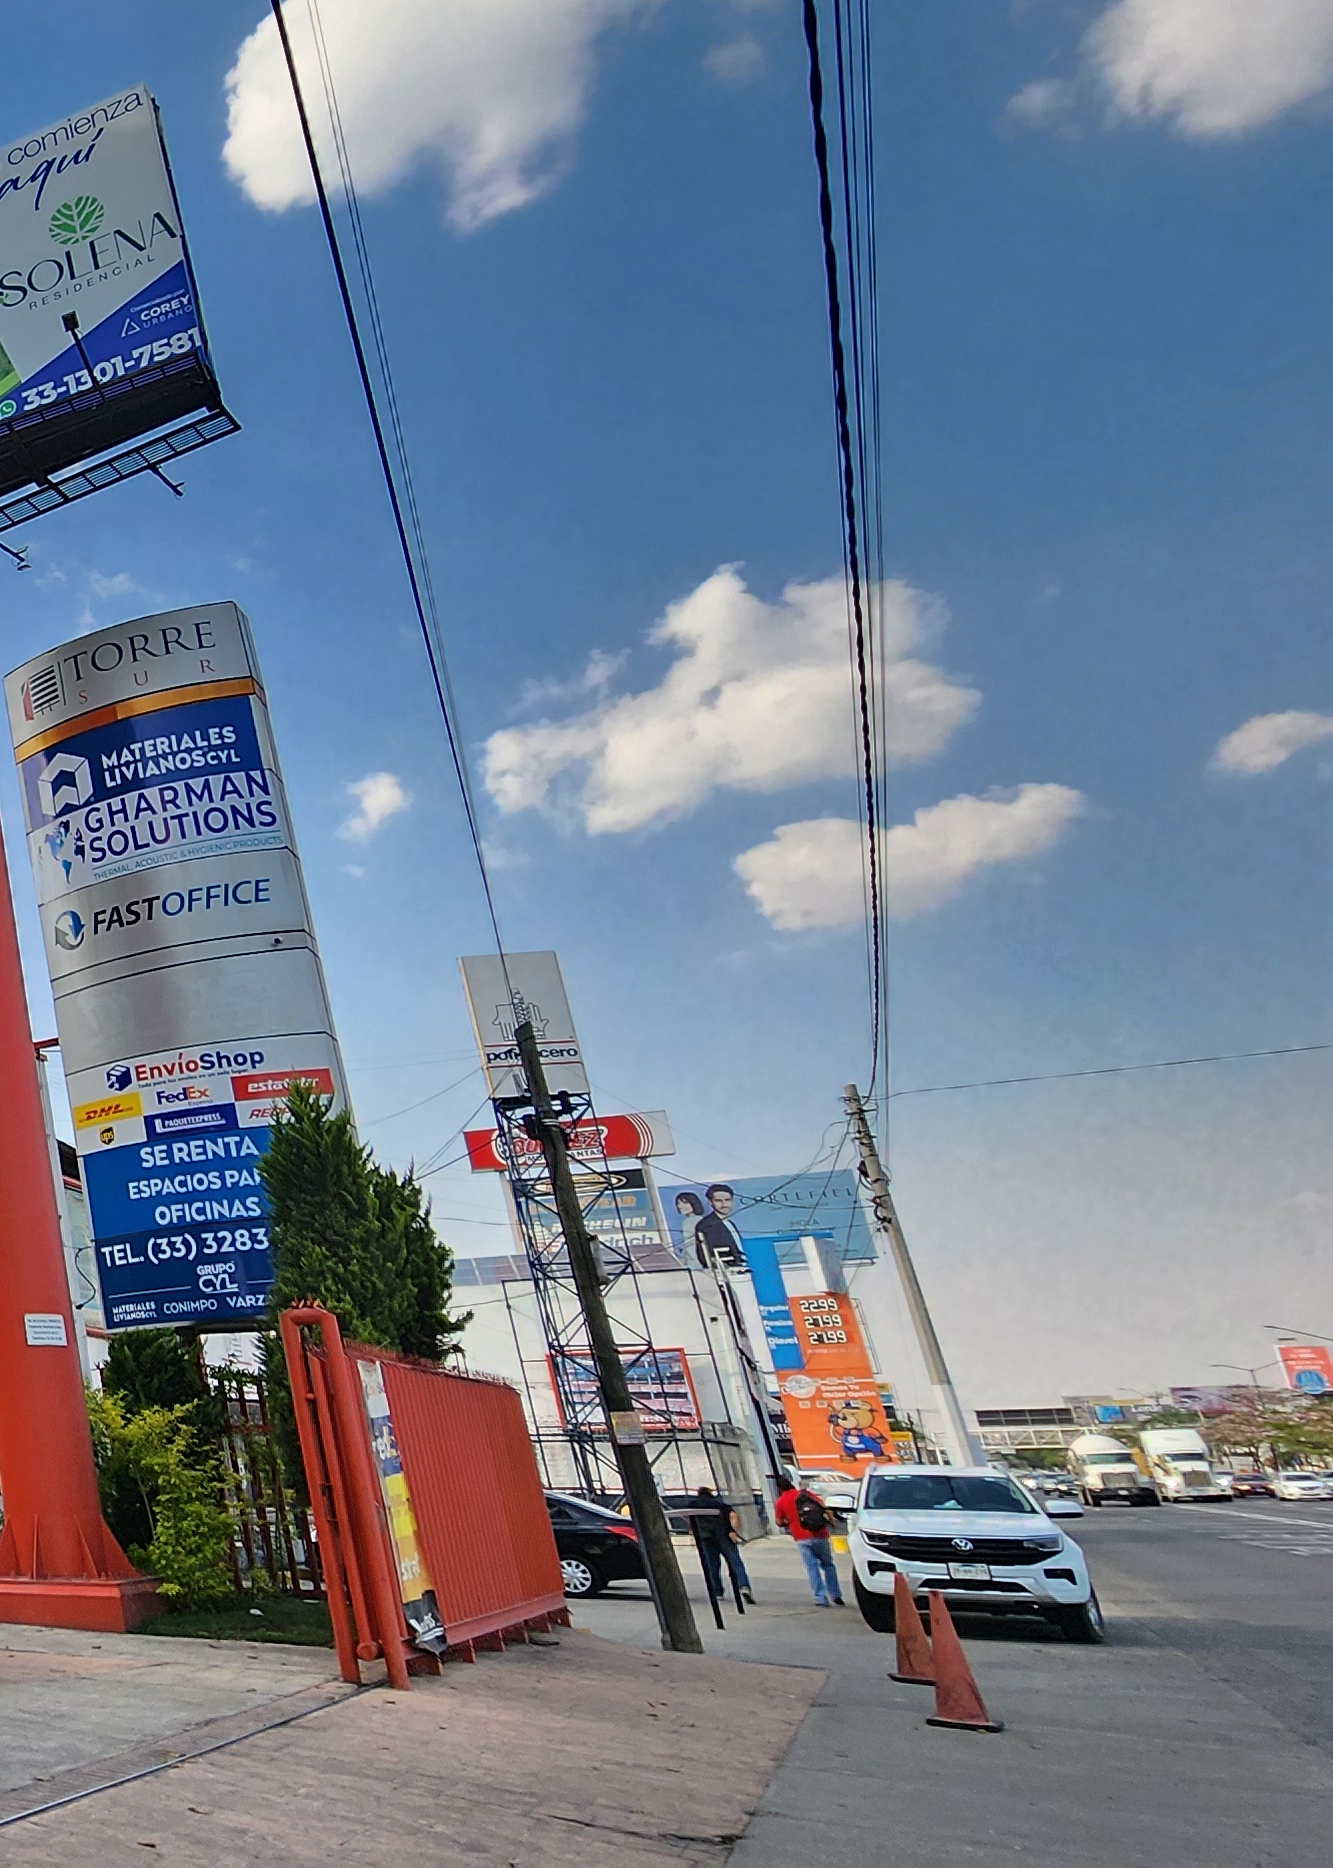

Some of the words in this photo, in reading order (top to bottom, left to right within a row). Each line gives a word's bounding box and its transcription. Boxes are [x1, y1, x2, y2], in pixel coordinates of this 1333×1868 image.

[8, 92, 143, 165] comienza
[29, 256, 156, 311] RESIDENCIAL
[140, 294, 190, 320] COREY
[143, 304, 193, 328] URBANO
[21, 326, 202, 411] 33-1301-7581
[63, 620, 217, 682] TORRE
[101, 726, 237, 769] MATERIALES
[84, 770, 271, 834] GHARMAN
[90, 800, 278, 864] SOLUTIONS
[135, 852, 178, 871] ACOUSTIC
[233, 834, 283, 850] PRODUCTS
[85, 1103, 124, 1121] DHL
[156, 1086, 210, 1105] FedEx
[140, 1145, 169, 1168] SE
[172, 1135, 260, 1163] RENTA
[128, 1173, 222, 1200] ESPACIOS
[155, 1196, 262, 1226] OFICINAS
[101, 1242, 144, 1268] TEL.
[147, 1232, 197, 1264] (33)
[202, 1227, 269, 1255] 3283
[196, 1262, 236, 1276] GRUPO
[198, 1273, 239, 1294] CYL
[112, 1301, 156, 1314] MATERIALES
[163, 1299, 218, 1315] CONIMPO
